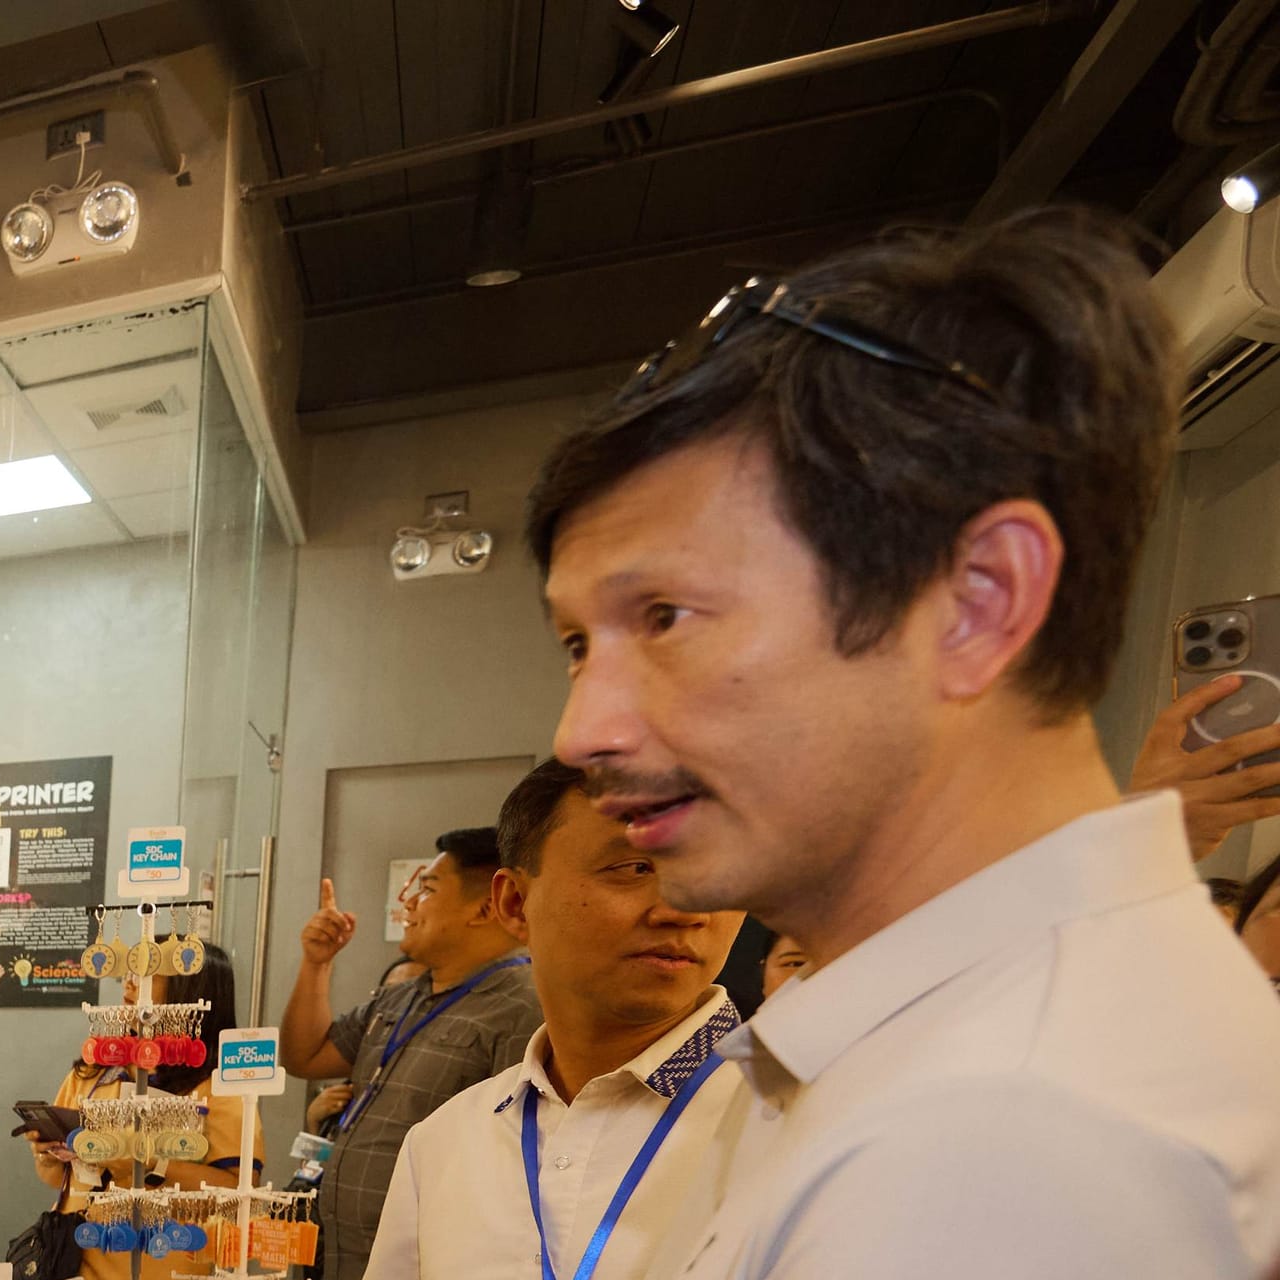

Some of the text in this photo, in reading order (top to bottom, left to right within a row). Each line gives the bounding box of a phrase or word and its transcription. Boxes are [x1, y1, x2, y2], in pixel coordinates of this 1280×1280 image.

[19, 828, 39, 839] TRY
[145, 845, 163, 854] SDC
[133, 852, 177, 863] KEY CHAIN
[238, 1046, 258, 1056] SDC
[224, 1054, 274, 1064] KEY CHAIN
